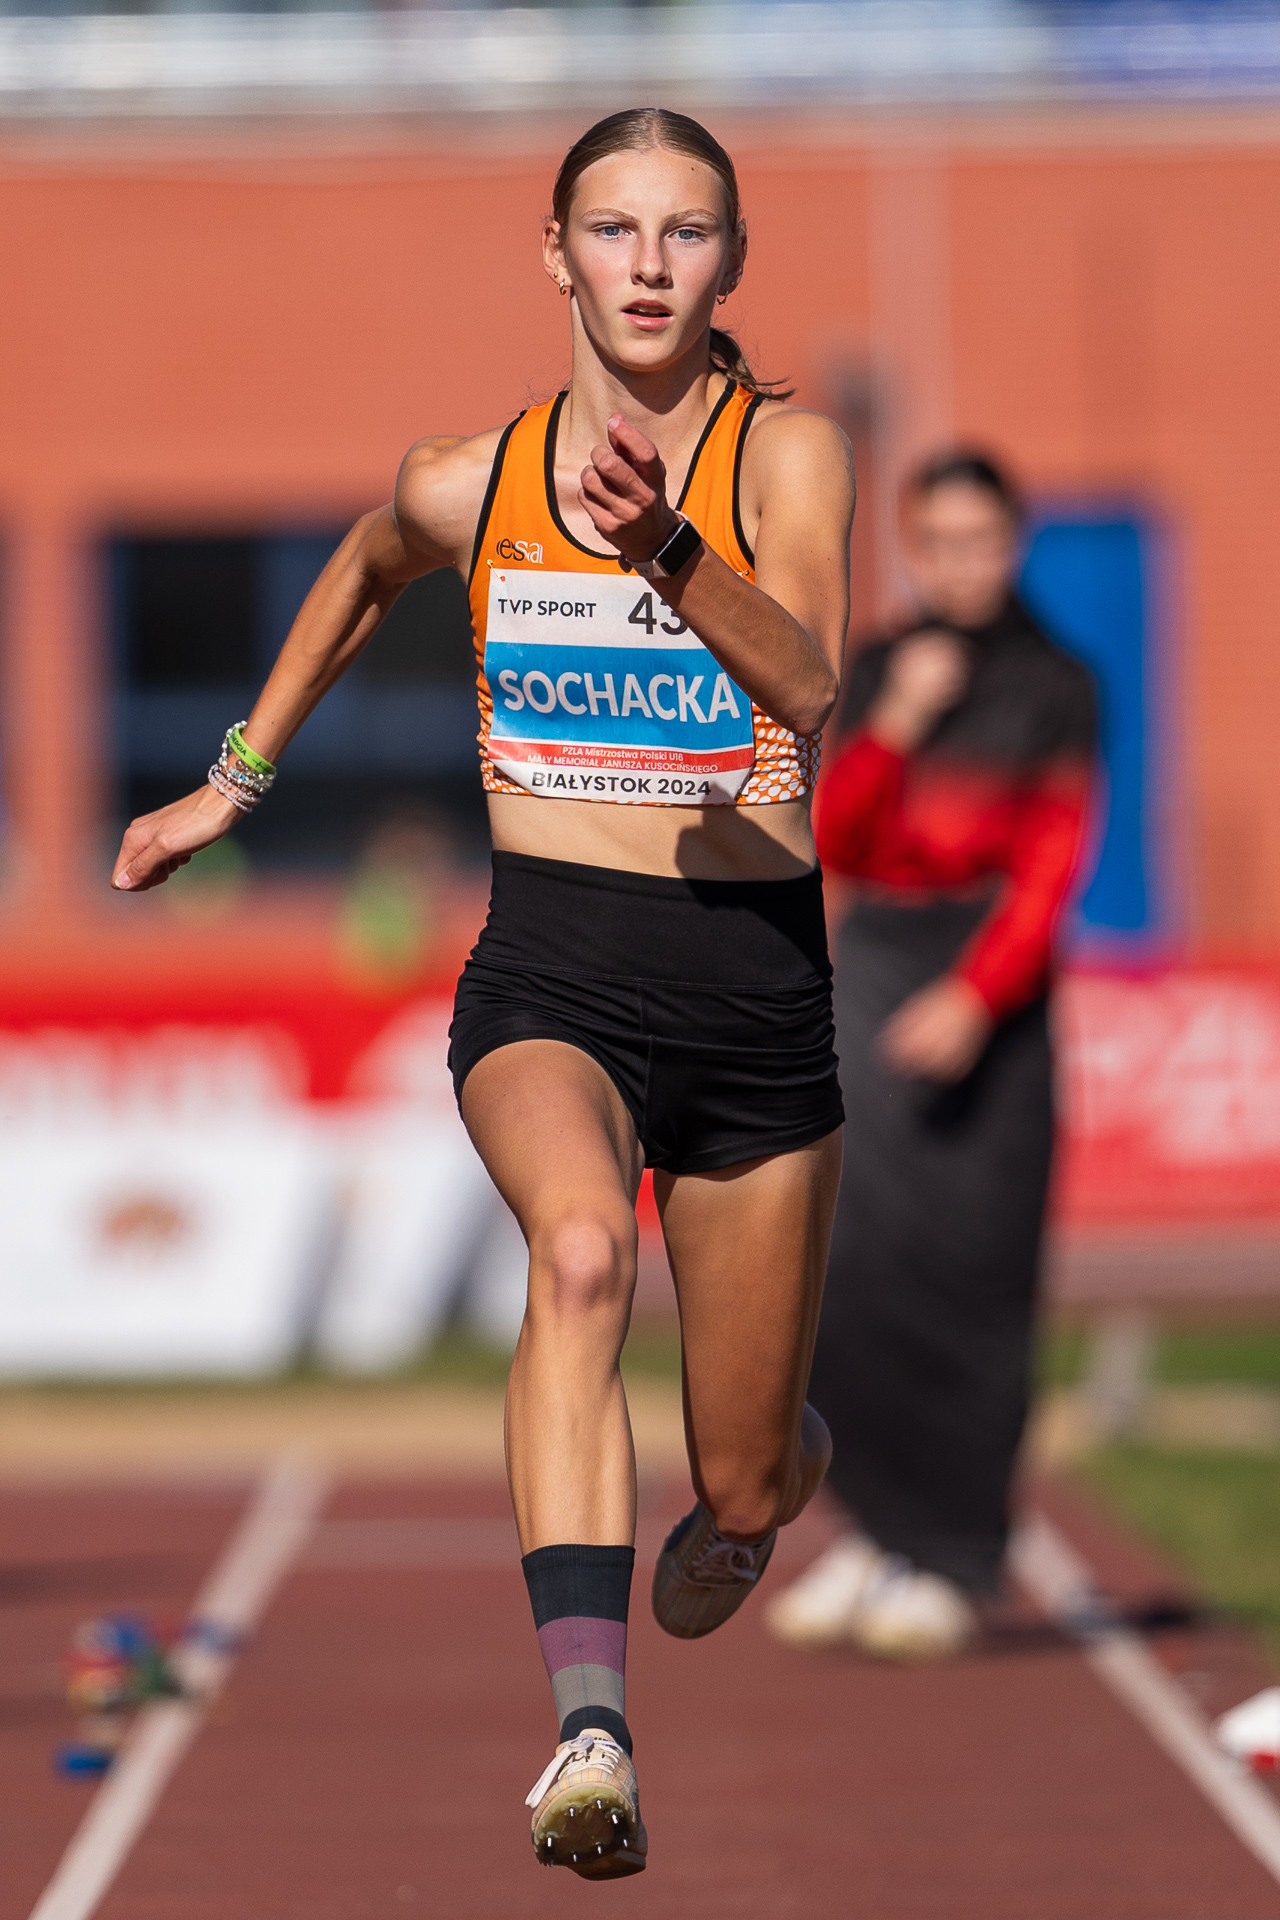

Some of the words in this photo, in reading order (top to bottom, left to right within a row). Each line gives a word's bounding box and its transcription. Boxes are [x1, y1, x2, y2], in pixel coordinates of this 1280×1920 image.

[498, 599, 533, 615] TVP
[537, 600, 597, 618] SPORT
[498, 669, 741, 723] SOCHACKA
[562, 746, 583, 756] PZLA
[585, 747, 638, 760] Mistrzostwa
[640, 751, 667, 761] Polski
[527, 754, 552, 764] MAŁY
[553, 756, 600, 768] MEMORIAŁ
[601, 761, 642, 770] JANUSZA
[644, 761, 718, 773] KUSOCIŃSKIEGO
[531, 771, 652, 795] BIAŁYSTOK
[657, 778, 712, 796] 2024
